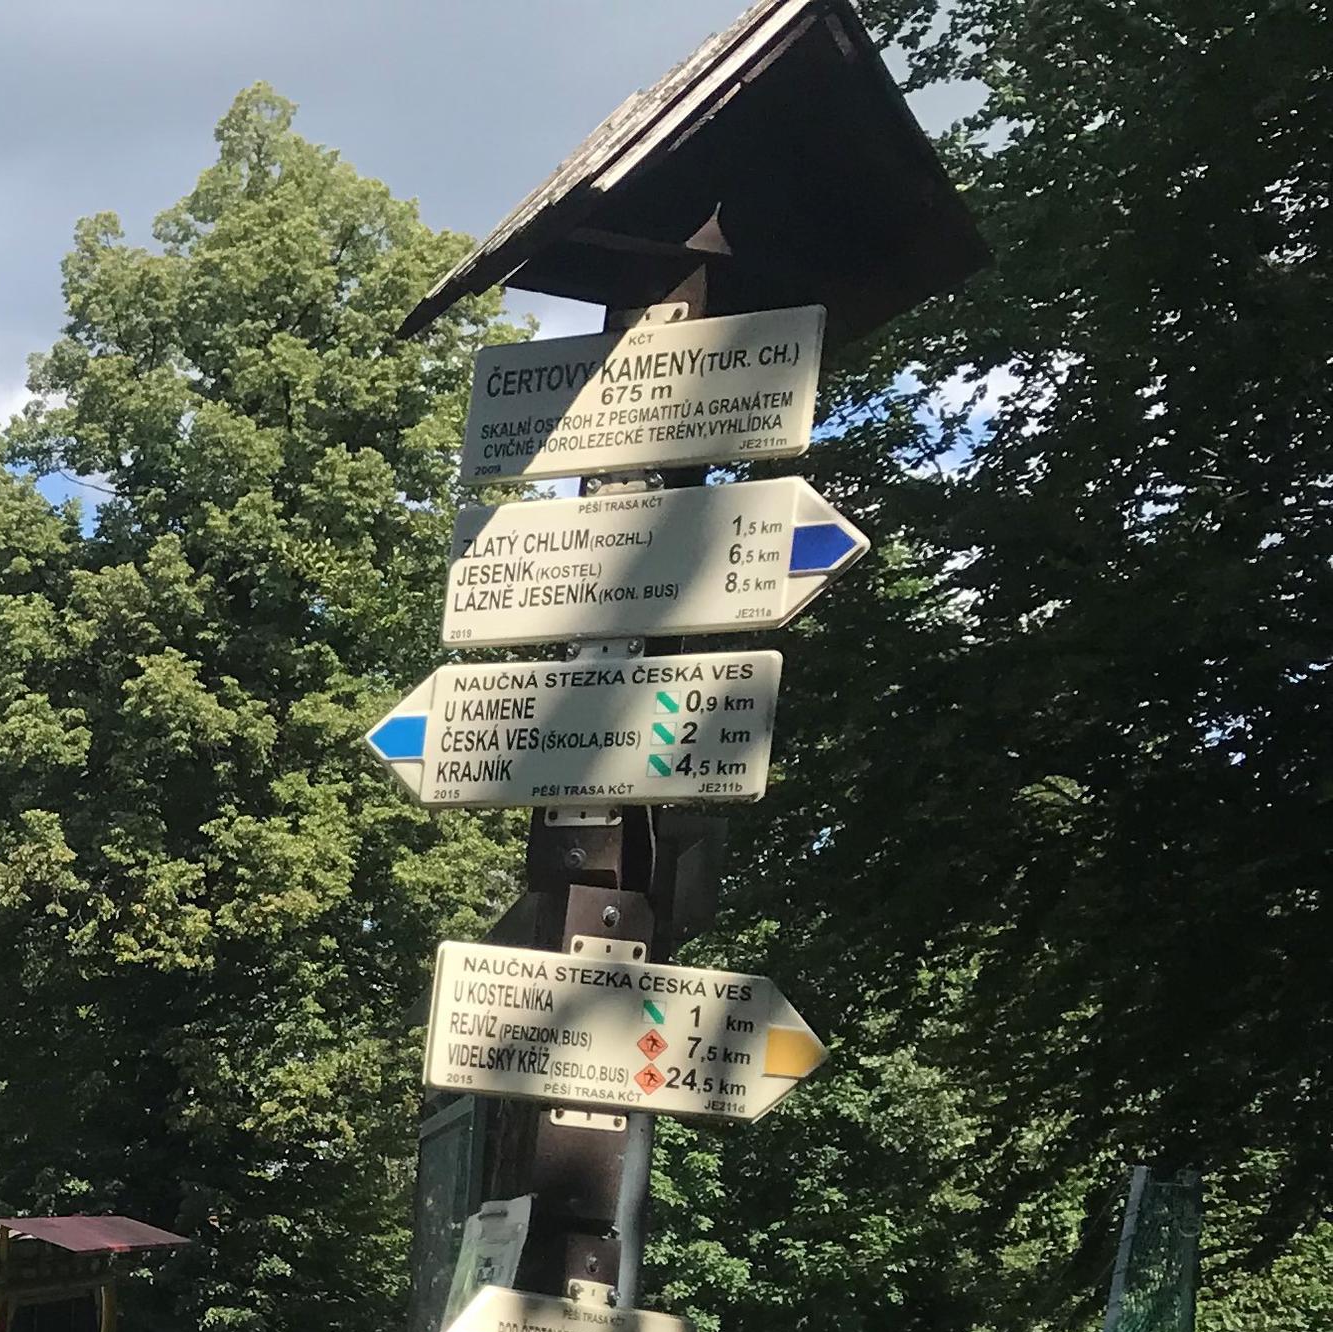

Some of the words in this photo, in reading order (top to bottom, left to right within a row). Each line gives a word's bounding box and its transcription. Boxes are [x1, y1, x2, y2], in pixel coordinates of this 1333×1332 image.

[629, 333, 654, 347] KČT
[486, 360, 596, 398] ČERTOVY
[758, 342, 800, 368] CH.)
[601, 384, 643, 406] 675
[650, 384, 673, 400] m
[480, 417, 532, 440] SKALNÍ
[533, 412, 594, 435] OSTROH
[596, 412, 606, 428] Z
[609, 402, 691, 427] PEGMATITŮ
[694, 401, 706, 417] A
[709, 389, 793, 415] GRANÁTEM
[483, 435, 534, 459] CVIČNÉ
[537, 426, 643, 455] HOROLEZECKÉ
[739, 436, 788, 451] JE211m
[579, 500, 602, 515] PĚŠÍ
[604, 499, 639, 514] TRASA
[641, 497, 663, 511] KČT
[461, 528, 518, 560] ZLATÝ
[761, 520, 782, 534] km
[728, 543, 755, 565] 6,5
[758, 549, 780, 562] km
[454, 585, 513, 613] LÁZNĚ
[643, 583, 680, 601] BUS)
[724, 571, 751, 594] 8,5
[754, 578, 776, 592] km
[450, 628, 472, 640] 2019
[735, 606, 772, 620] JE211a
[454, 669, 538, 692] NAUČNÁ
[545, 670, 625, 689] STEZKA
[632, 662, 704, 685] ČESKÁ
[712, 663, 754, 681] VES
[444, 703, 456, 722] U
[460, 698, 536, 722] KAMENE
[685, 690, 718, 714] 0,9
[724, 695, 755, 711] km
[441, 723, 499, 753] ČESKÁ
[680, 722, 698, 745] 2
[720, 728, 751, 744] km
[436, 752, 511, 784] KRAJNÍK
[676, 752, 710, 777] 4,5
[716, 759, 747, 776] km
[433, 789, 460, 801] 2015
[532, 782, 560, 797] PĚŠÍ
[564, 785, 605, 797] TRASA
[608, 782, 635, 796] KČT
[698, 782, 744, 795] JE211b
[463, 955, 548, 981] NAUČNÁ
[556, 965, 632, 990] STEZKA
[638, 971, 706, 997] ČESKÁ
[714, 982, 752, 1002] VES
[453, 980, 463, 1003] U
[466, 981, 554, 1014] KOSTELNÍKA
[689, 1004, 702, 1028] 1
[726, 1015, 754, 1034] km
[449, 1008, 496, 1039] REJVÍZ
[687, 1035, 719, 1063] 7,5
[722, 1047, 751, 1066] km
[448, 1042, 516, 1073] VIDELSKÝ
[665, 1066, 714, 1095] 24,5
[718, 1078, 747, 1098] km
[446, 1072, 474, 1087] 2015
[543, 1082, 572, 1098] PĚŠÍ
[574, 1085, 615, 1102] TRASA
[617, 1087, 642, 1103] KČT
[704, 1099, 746, 1114] JE211d
[583, 1312, 609, 1325] TRASA
